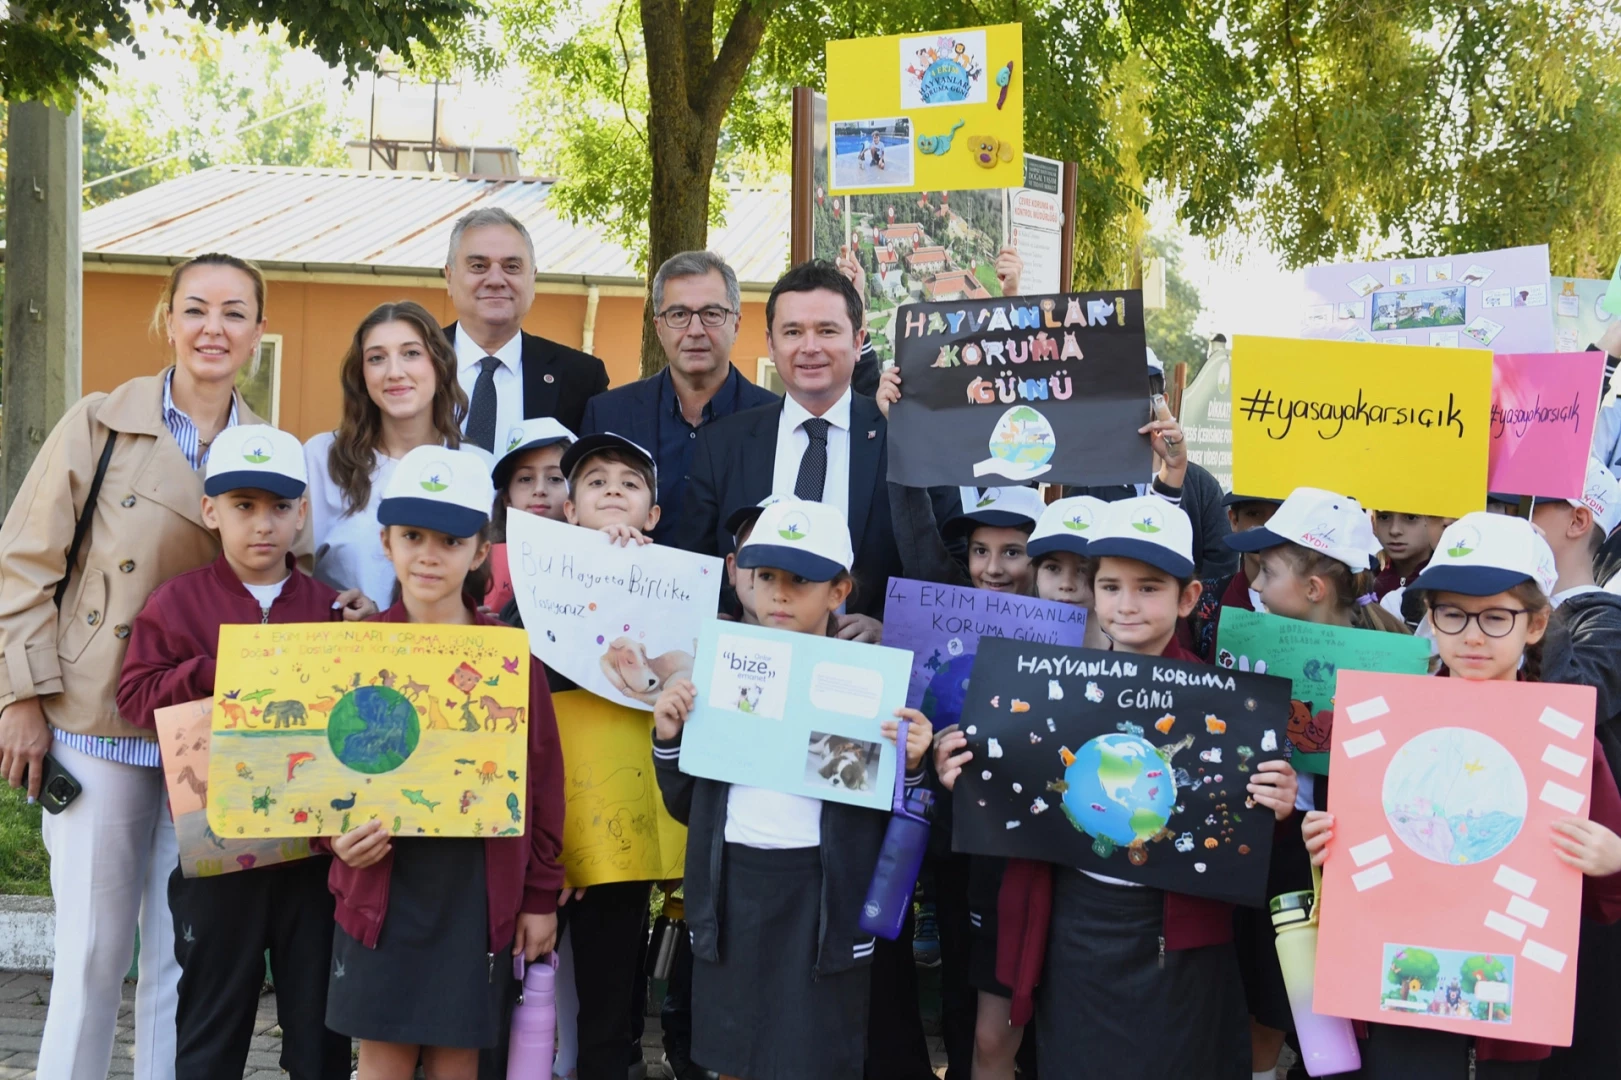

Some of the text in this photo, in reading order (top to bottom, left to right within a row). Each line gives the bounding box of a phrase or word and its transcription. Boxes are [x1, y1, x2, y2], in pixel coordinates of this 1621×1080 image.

[904, 297, 1125, 338] HAYVANLARI
[930, 331, 1084, 368] KORUMA
[967, 369, 1073, 404] GÜNÜ
[628, 564, 690, 601] Birlikte
[888, 581, 1086, 626] 4 EKİM HAYVANLARI
[932, 612, 1005, 639] KORUMA
[1017, 655, 1236, 691] HAYVANLARI KORUMA
[1117, 689, 1174, 709] GÜNÜ
